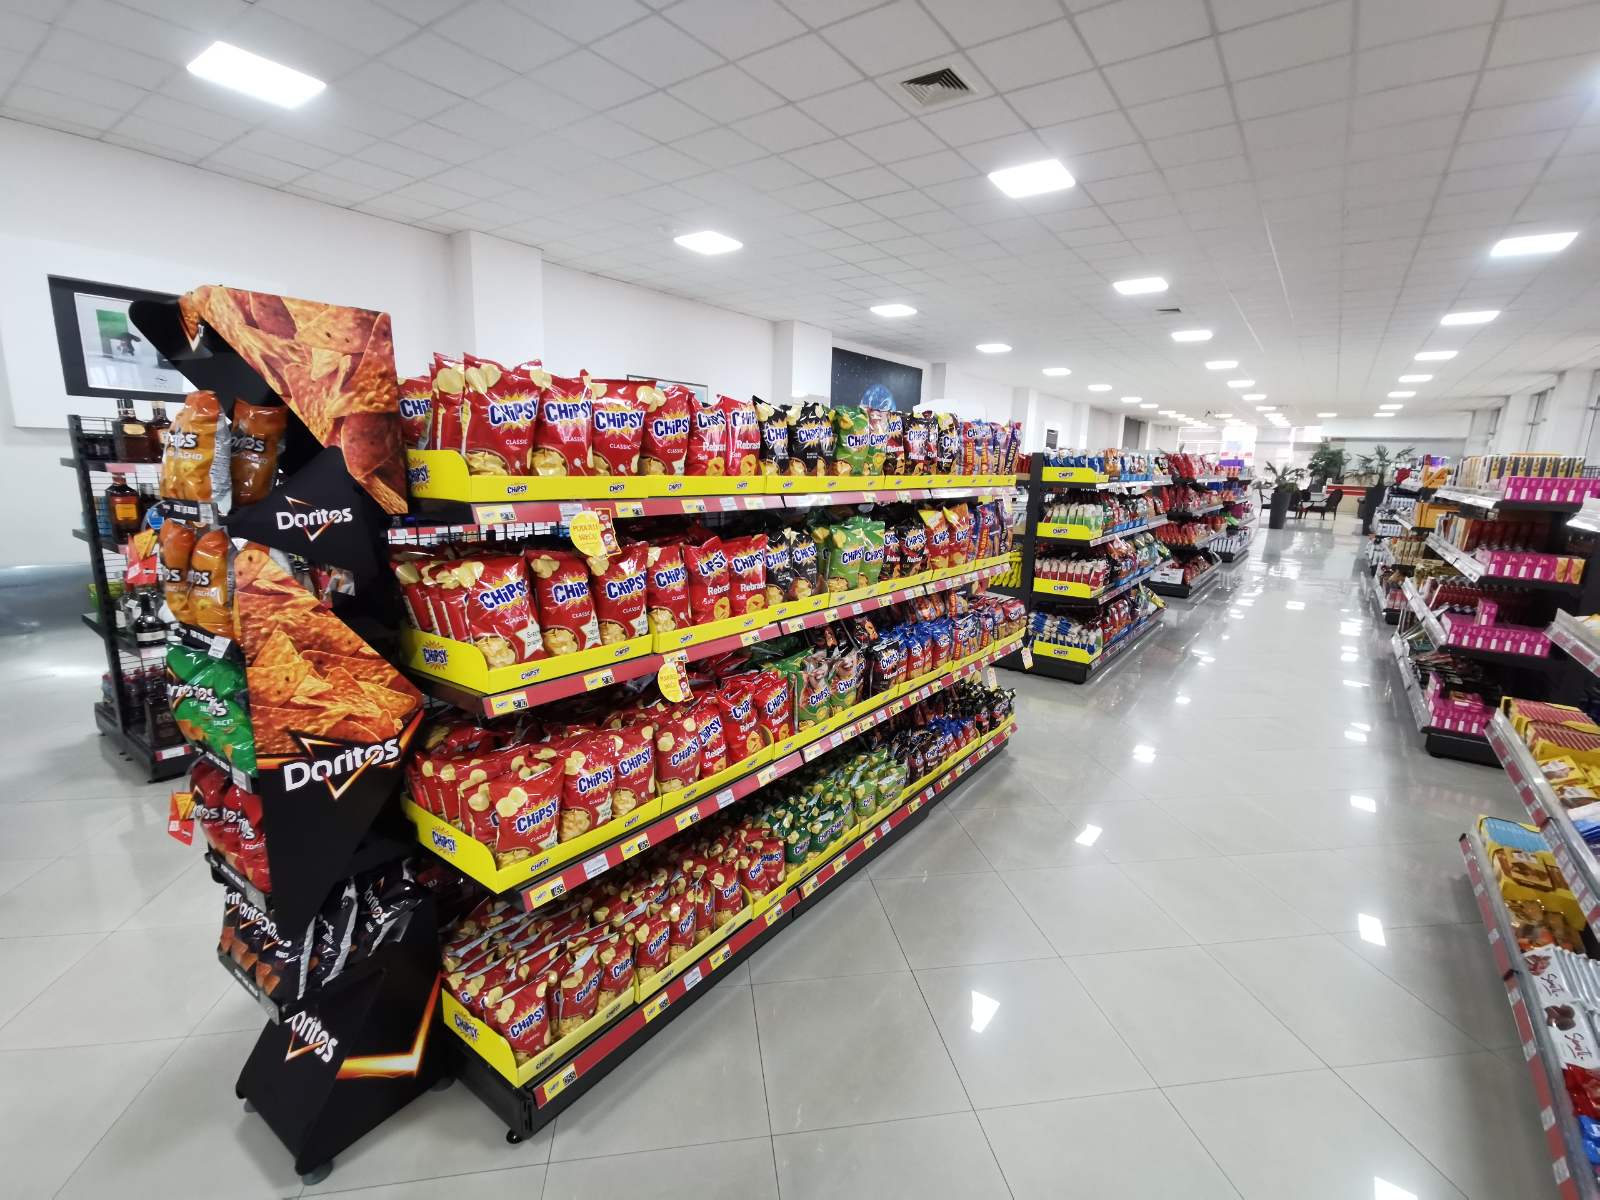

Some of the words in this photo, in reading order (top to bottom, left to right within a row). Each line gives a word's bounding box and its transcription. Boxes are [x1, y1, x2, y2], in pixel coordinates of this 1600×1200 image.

[594, 410, 645, 432] CHiPSY
[505, 438, 529, 446] CLASSIC
[609, 443, 632, 451] CLASSIC
[276, 506, 353, 531] Doritos
[479, 579, 529, 611] CHiPSY
[622, 605, 641, 614] CLASSIC
[283, 738, 399, 792] Doritos
[618, 747, 651, 776] CHiPSY
[577, 765, 614, 793] CHiPSY
[516, 797, 559, 832] CHiPSY
[648, 926, 670, 956] CHiPSY
[510, 1004, 546, 1039] CHiPSY
